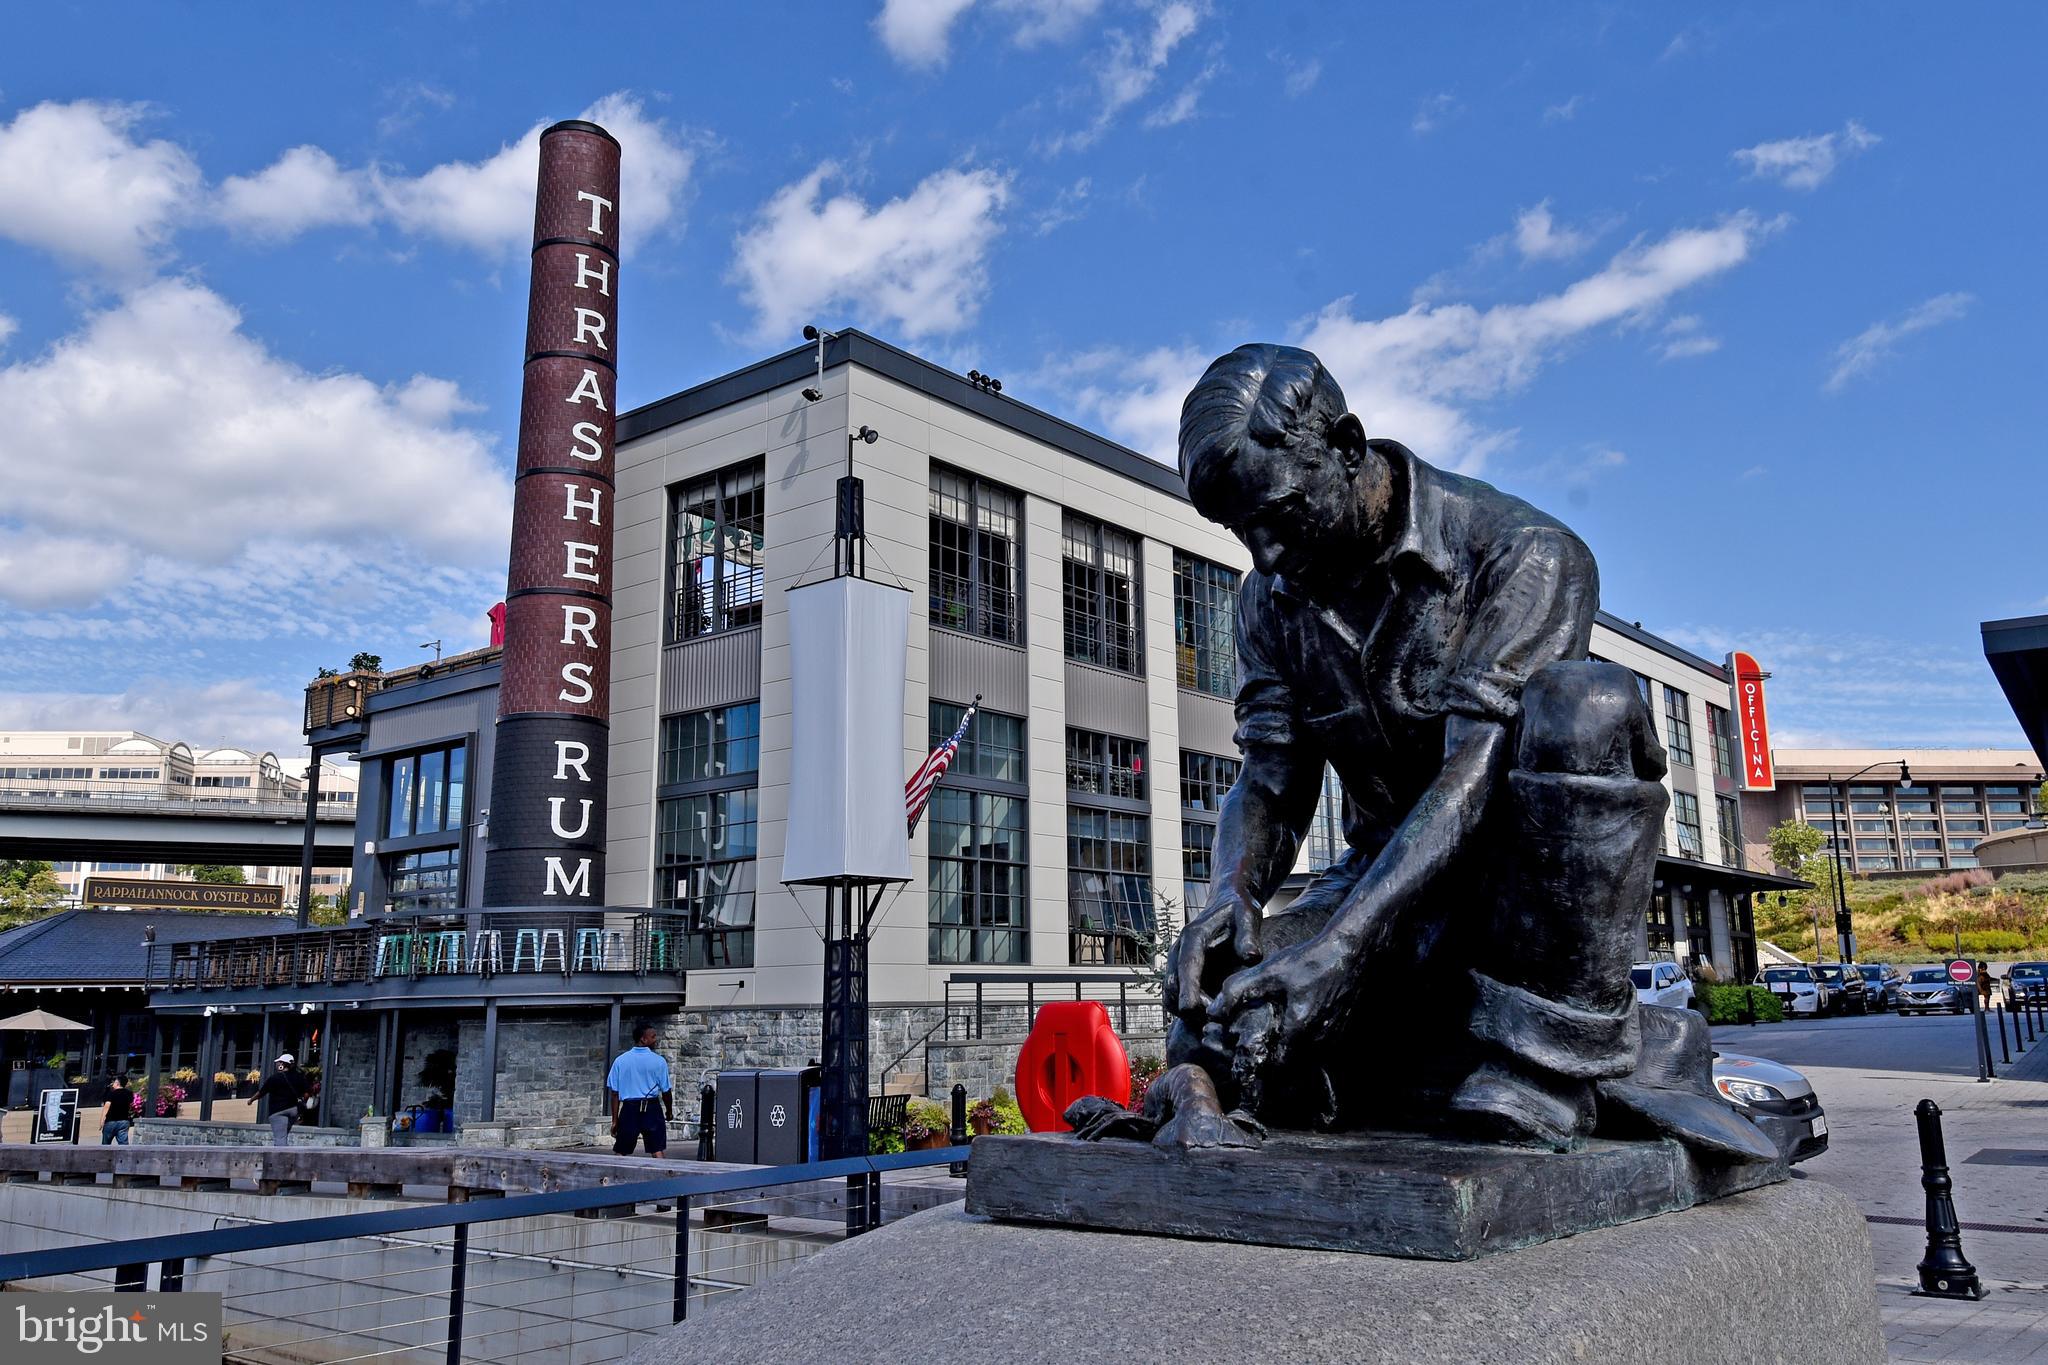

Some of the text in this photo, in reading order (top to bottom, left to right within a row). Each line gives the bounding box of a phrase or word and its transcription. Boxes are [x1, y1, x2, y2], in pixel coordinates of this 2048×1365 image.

[558, 190, 613, 704] THRASHERS
[1745, 683, 1763, 778] OFFICINA
[543, 740, 593, 897] RUM
[94, 886, 276, 905] RAPPAHANNOCK OYSTER BAR
